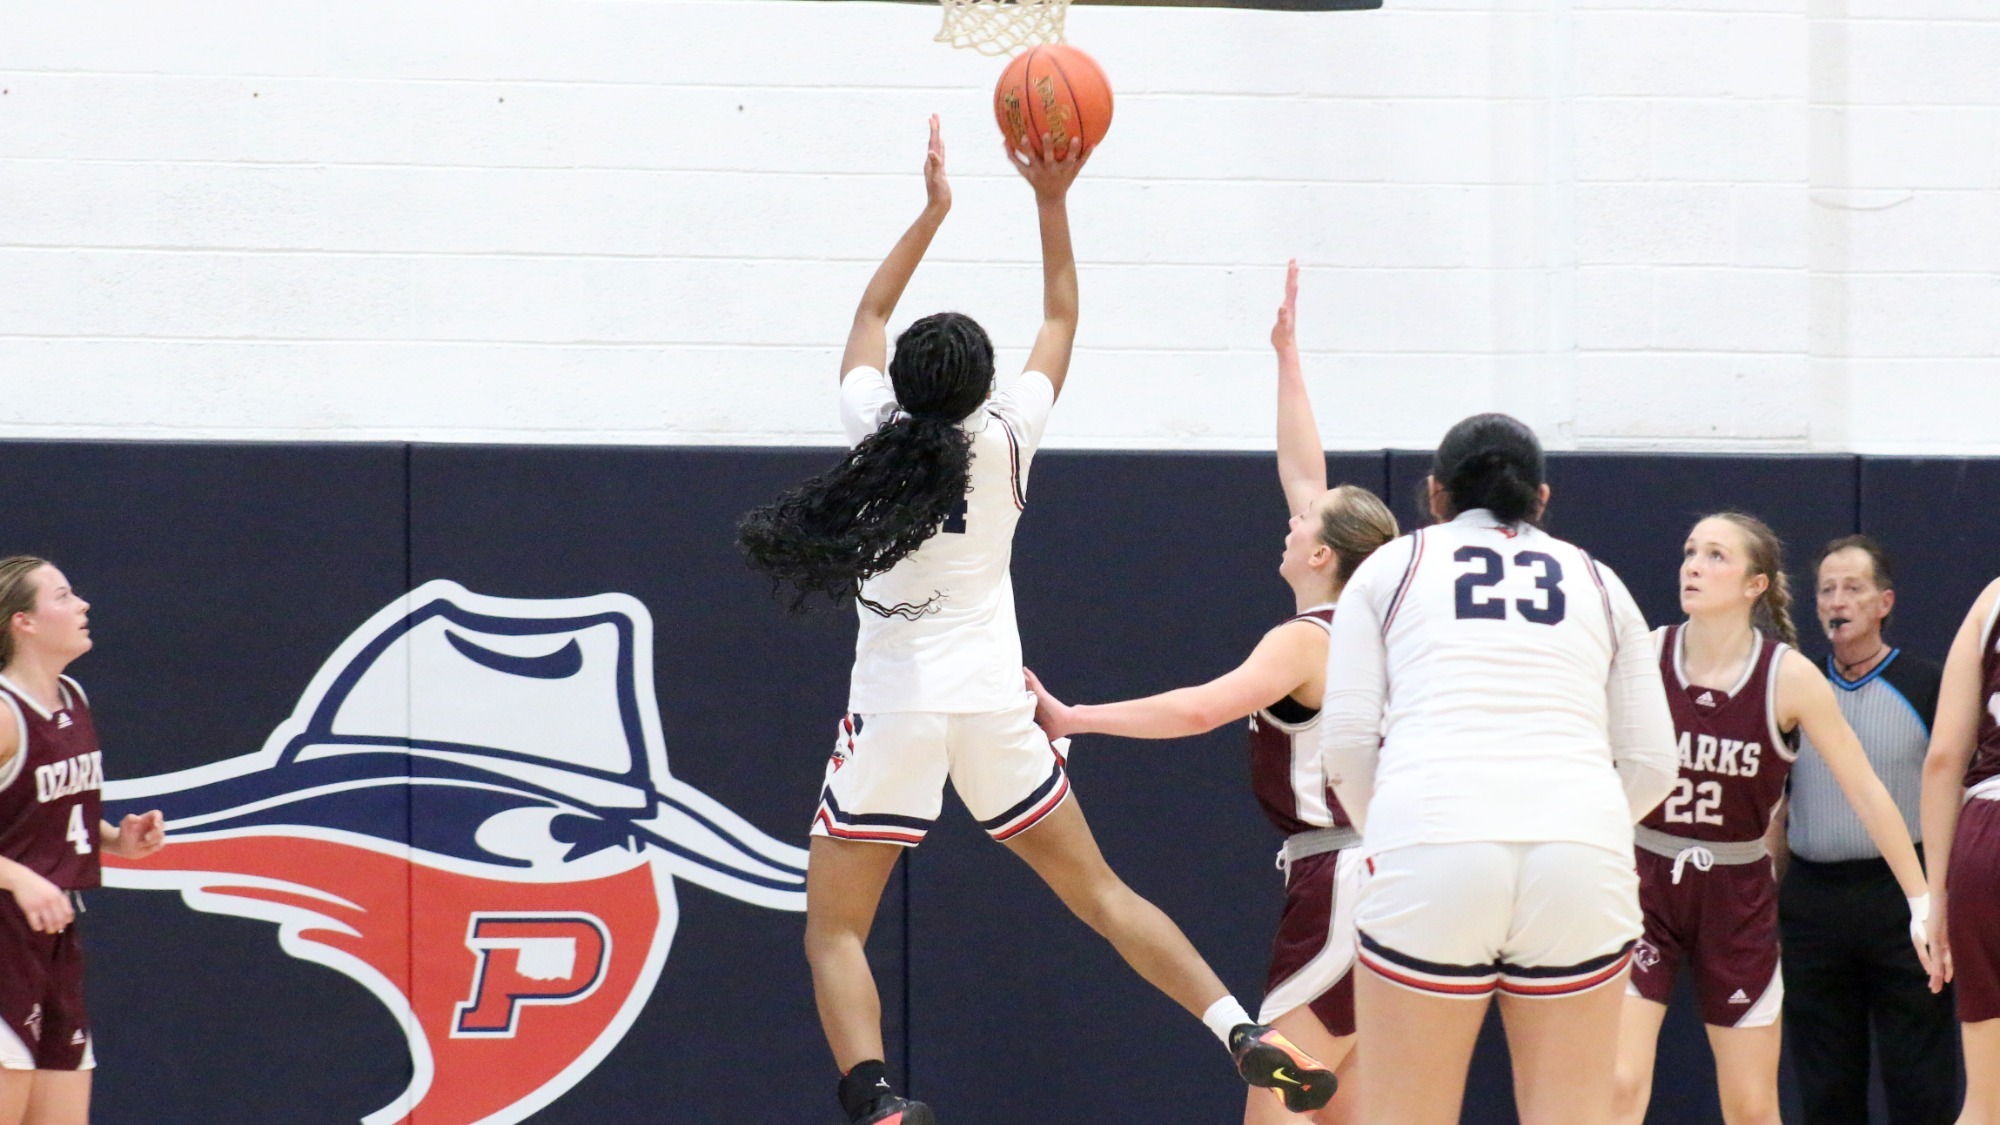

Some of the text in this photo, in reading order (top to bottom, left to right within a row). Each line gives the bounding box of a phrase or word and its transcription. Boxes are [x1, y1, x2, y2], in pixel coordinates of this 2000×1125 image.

[1453, 545, 1566, 626] 23
[35, 750, 103, 803] OZARK
[1677, 731, 1761, 777] ARKS
[1664, 778, 1724, 826] 22
[66, 803, 92, 854] 4
[449, 911, 613, 1039] P
